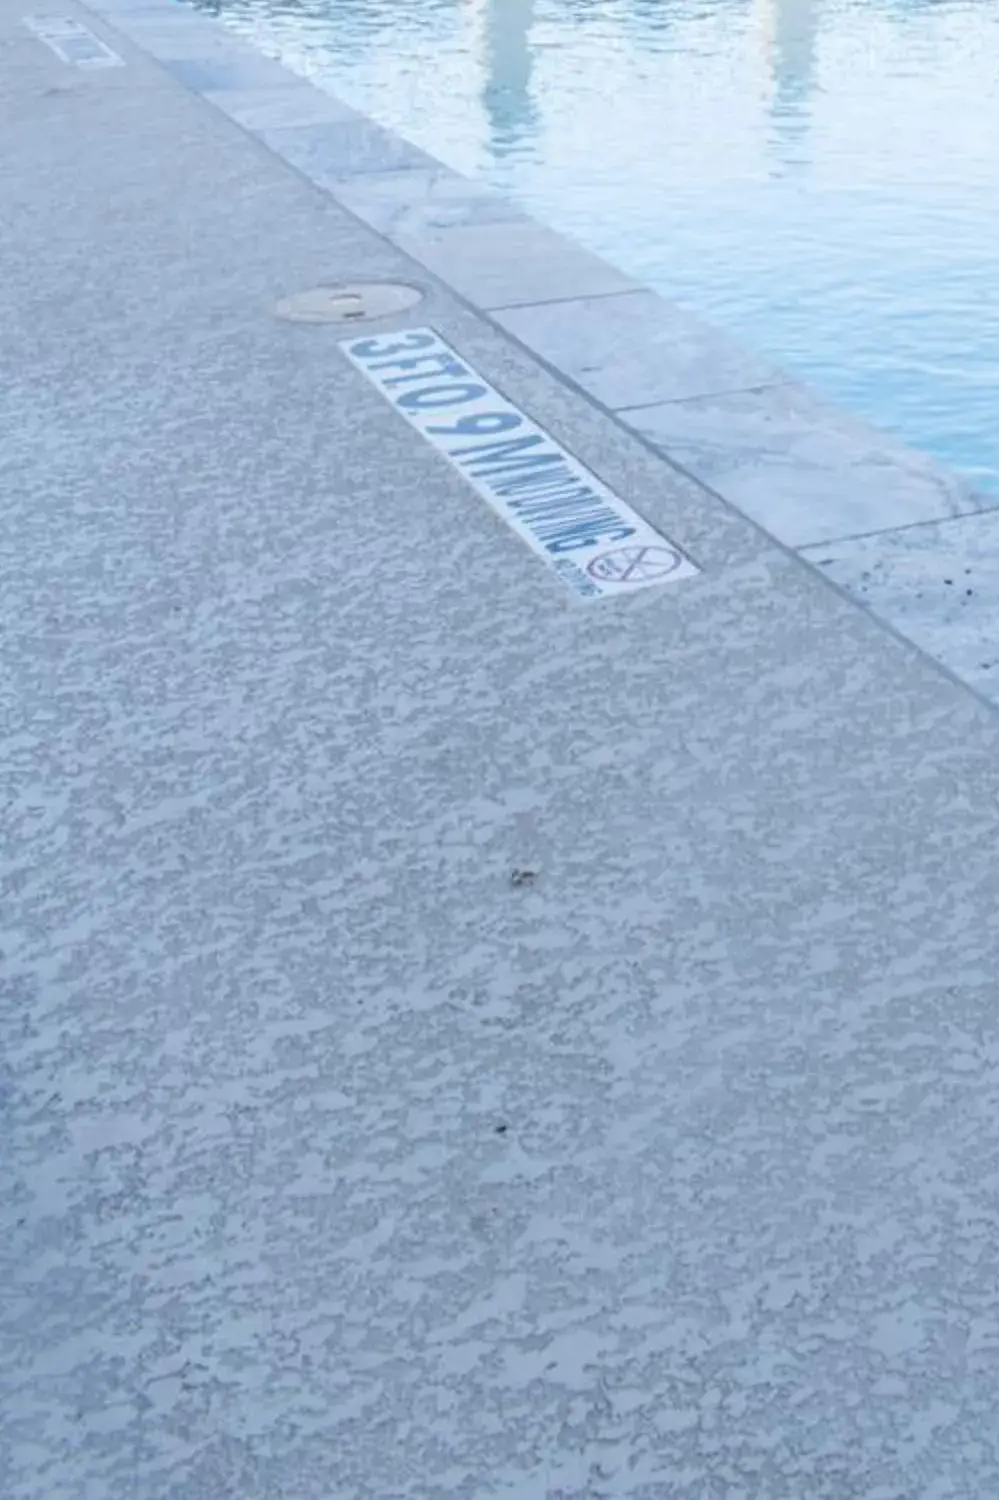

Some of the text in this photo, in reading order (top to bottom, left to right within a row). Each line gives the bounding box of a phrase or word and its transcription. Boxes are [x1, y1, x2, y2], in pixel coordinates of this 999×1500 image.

[350, 333, 436, 358] 3
[366, 352, 470, 385] FT
[449, 433, 567, 479] M
